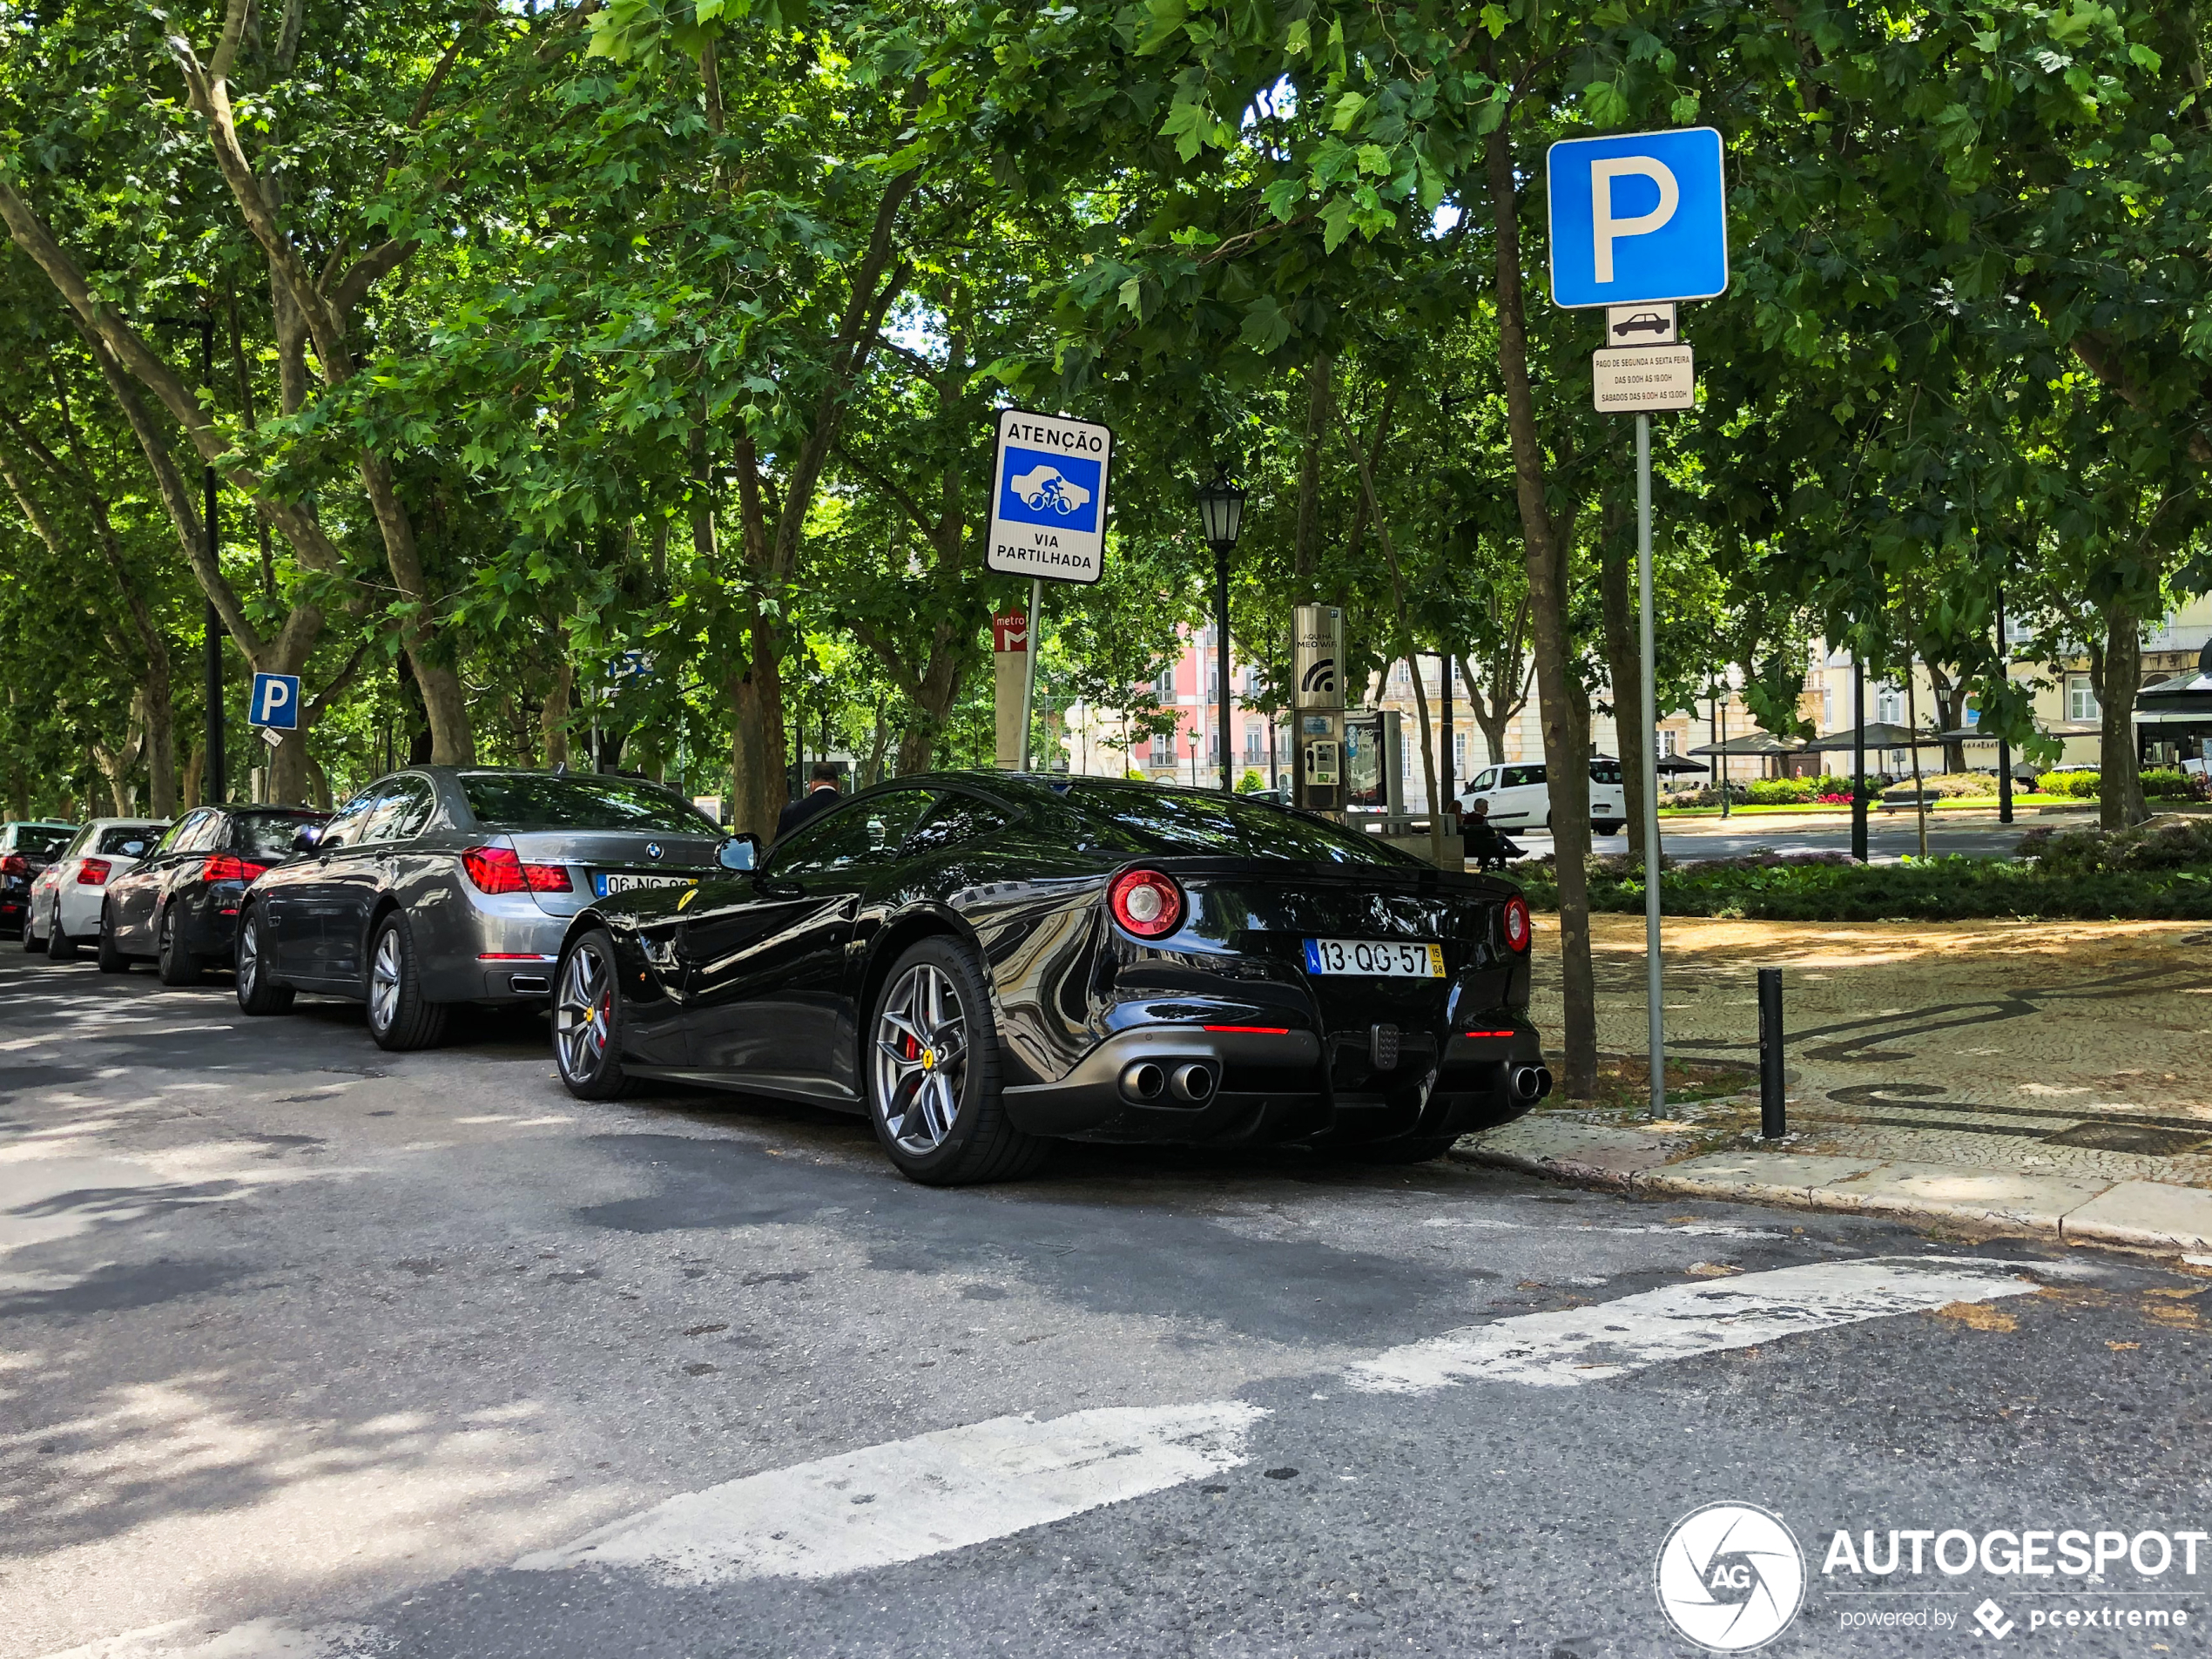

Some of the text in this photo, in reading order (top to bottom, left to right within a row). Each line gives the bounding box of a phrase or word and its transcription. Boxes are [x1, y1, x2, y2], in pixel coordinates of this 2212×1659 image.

[1590, 155, 1680, 284] P
[1595, 359, 1611, 368] PAGO
[1612, 358, 1620, 367] DE
[1621, 358, 1649, 367] SEGUNDA
[1655, 356, 1672, 365] SEXTA
[1673, 355, 1689, 364] FEIRA
[1602, 392, 1628, 401] SÁBADOS
[1629, 392, 1641, 401] DAS
[1008, 422, 1103, 453] ATENÇÃO
[1035, 533, 1058, 548] VIA
[997, 544, 1091, 569] PARTILHADA
[996, 616, 1025, 626] metro
[261, 679, 289, 721] P
[1431, 948, 1440, 958] 15
[1433, 964, 1443, 974] 08
